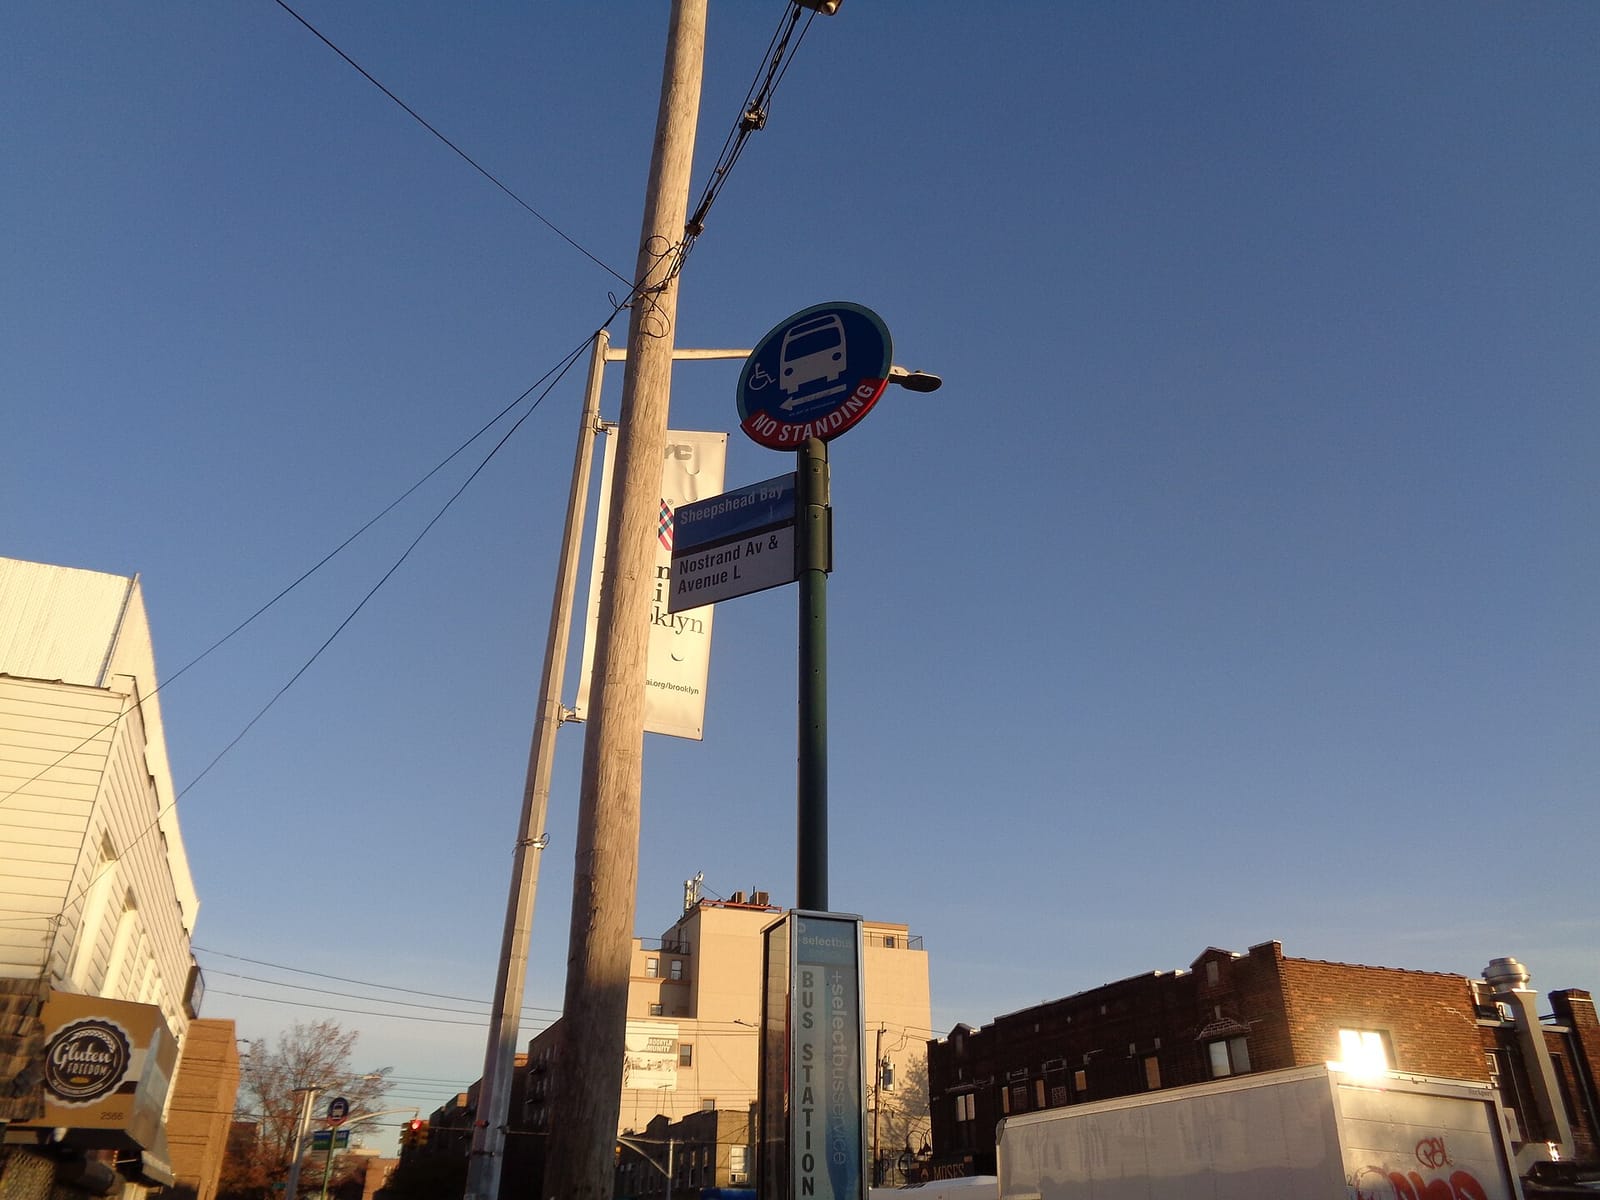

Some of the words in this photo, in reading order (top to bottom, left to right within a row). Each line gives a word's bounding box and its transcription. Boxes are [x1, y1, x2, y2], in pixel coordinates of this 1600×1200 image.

[751, 413, 778, 437] NO
[778, 383, 875, 442] STANDING
[680, 490, 756, 526] Sheepshead
[759, 484, 784, 501] Bay
[679, 545, 741, 576] Nostrand
[745, 538, 762, 558] Av
[768, 534, 779, 550] &
[678, 569, 729, 595] Avenue
[733, 564, 741, 581] L
[650, 606, 704, 635] klyn
[802, 971, 814, 1029] BUS
[53, 1042, 113, 1071] Gluten
[67, 1063, 109, 1076] FREEDOM
[802, 1043, 814, 1196] STATION
